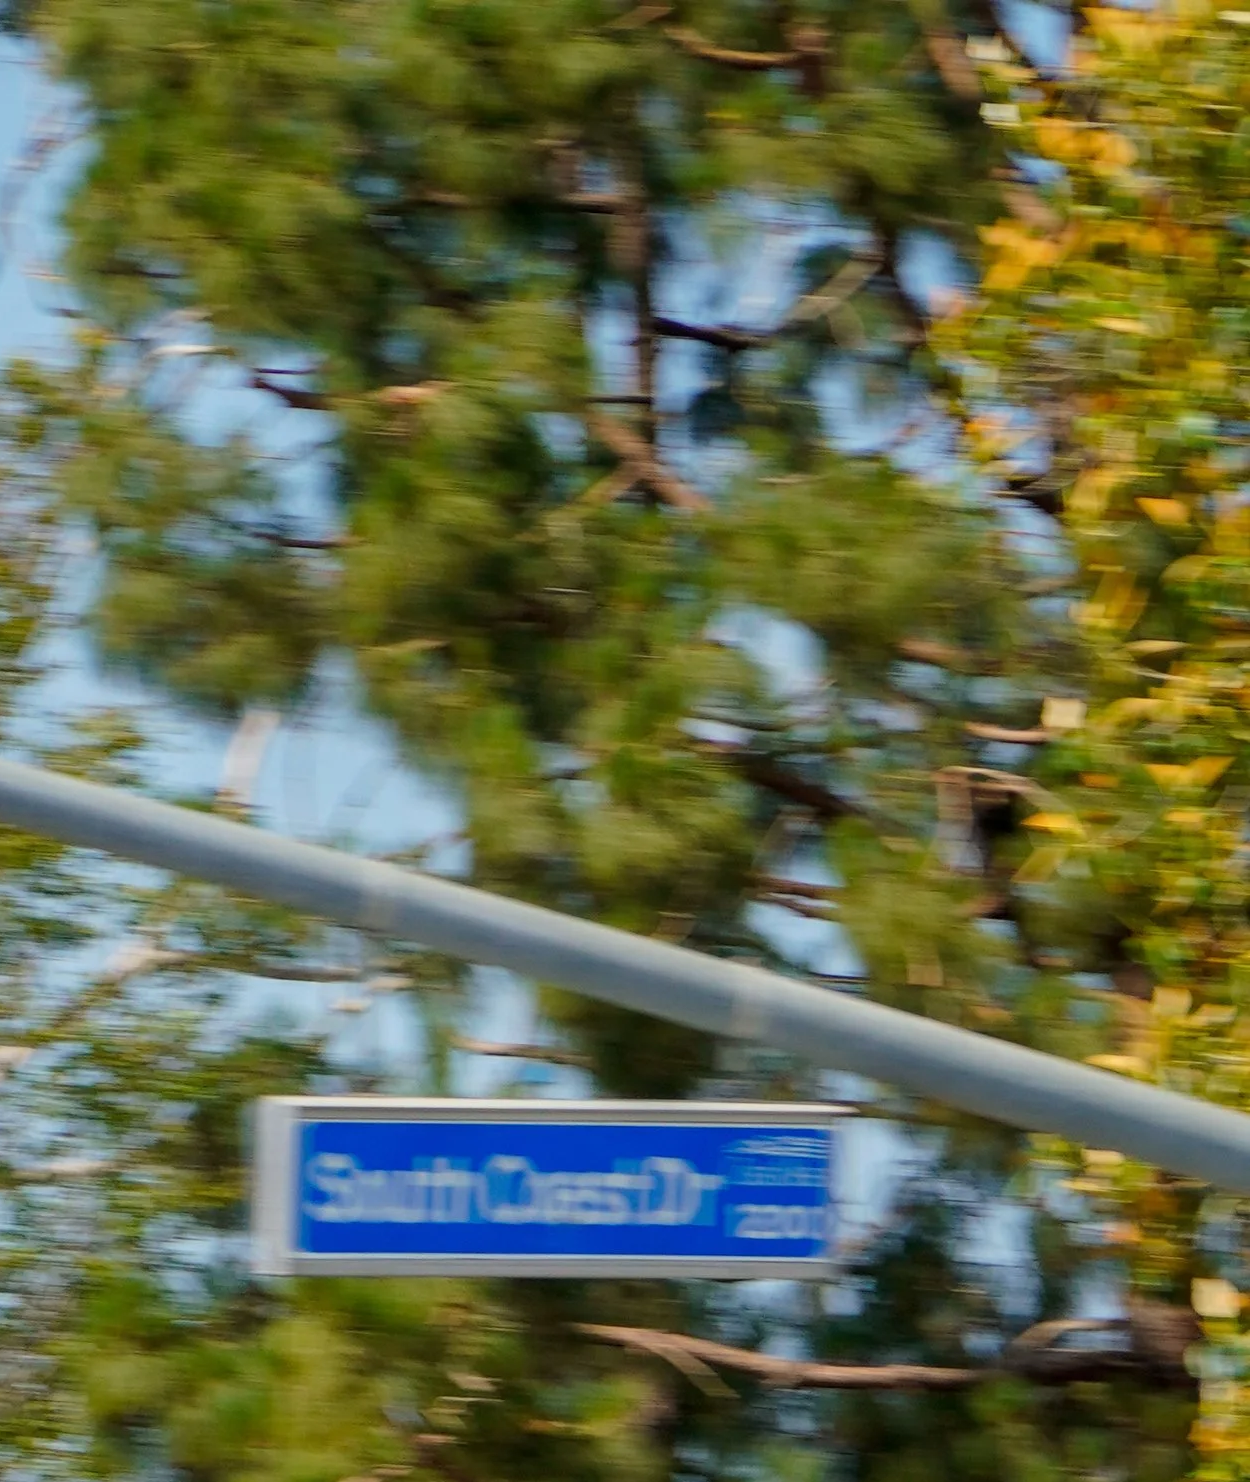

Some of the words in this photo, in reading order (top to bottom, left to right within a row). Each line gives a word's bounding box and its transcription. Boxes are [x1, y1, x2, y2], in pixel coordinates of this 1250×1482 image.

[302, 1152, 473, 1223] South
[481, 1153, 645, 1224] Coast
[639, 1156, 725, 1225] Dr
